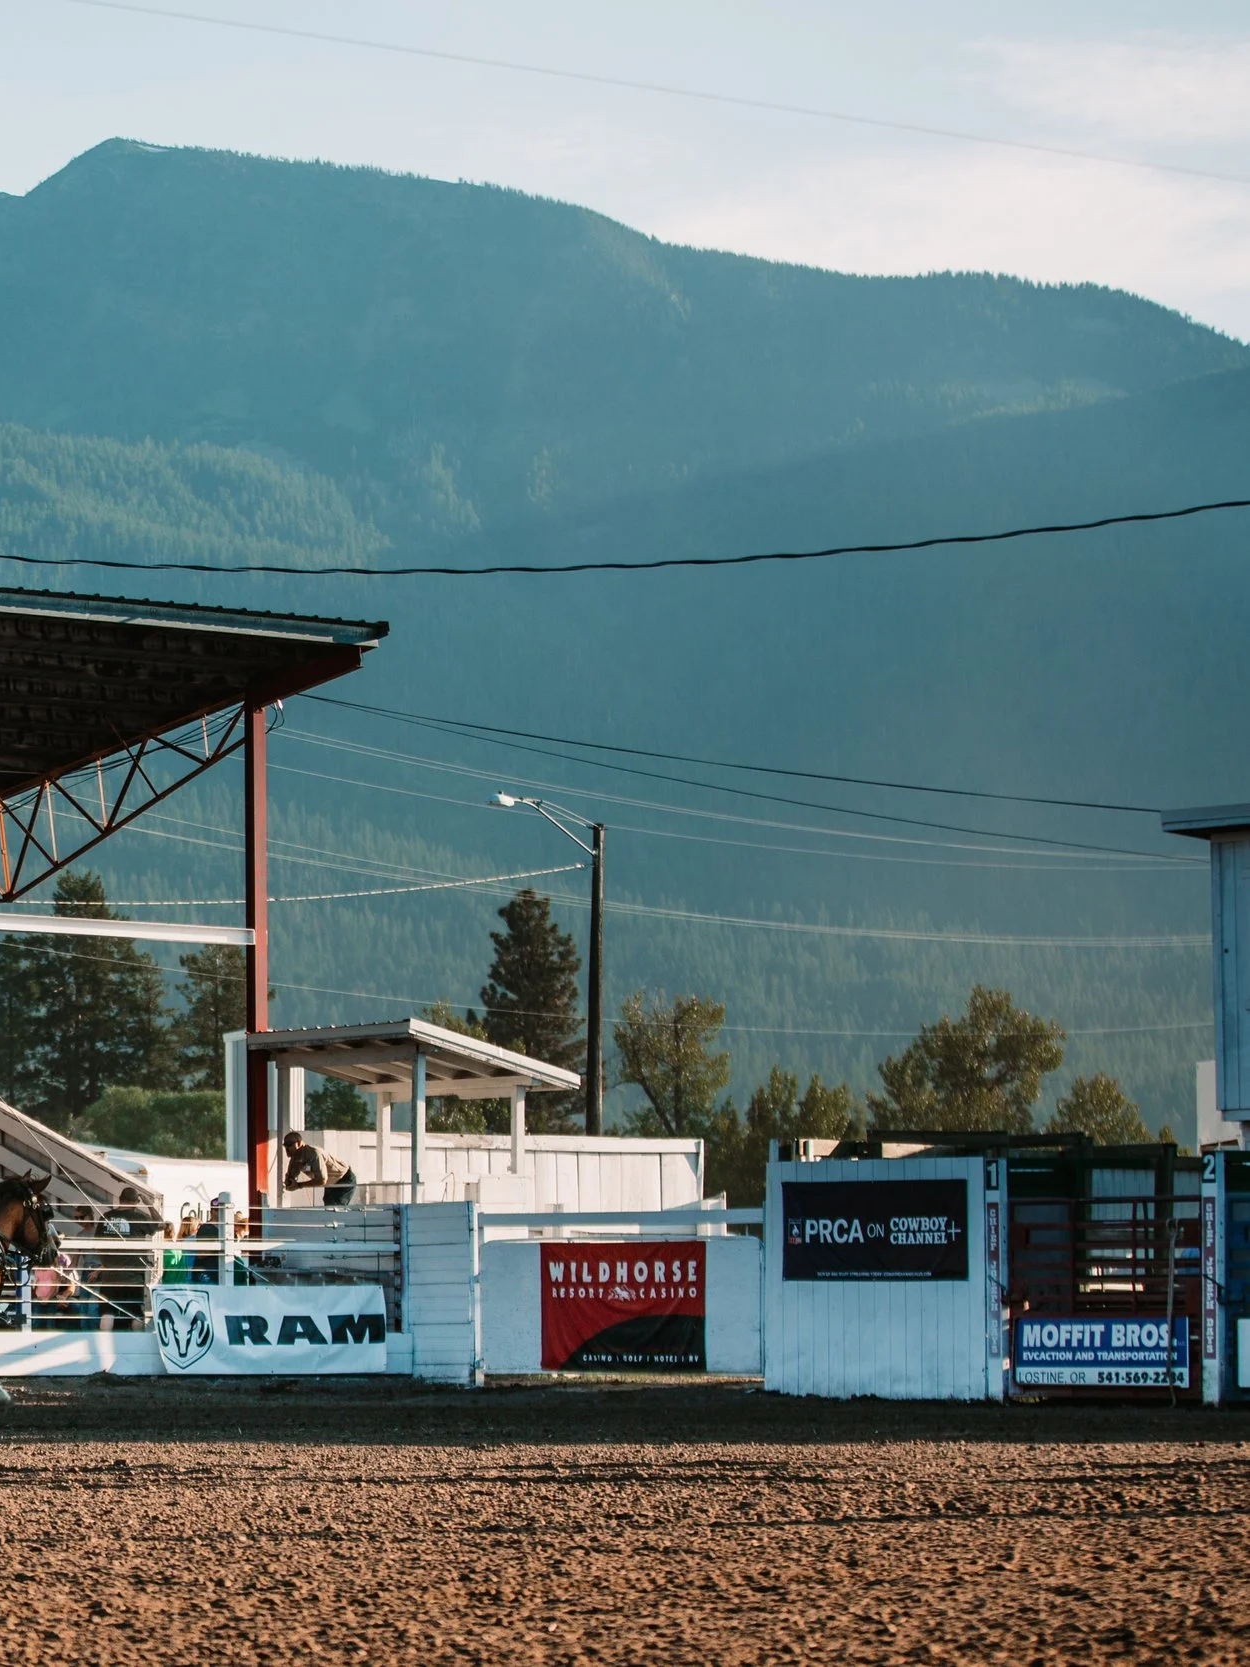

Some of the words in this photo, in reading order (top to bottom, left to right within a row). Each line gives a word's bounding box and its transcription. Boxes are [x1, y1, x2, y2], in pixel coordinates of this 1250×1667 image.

[987, 1162, 997, 1187] 1
[1203, 1154, 1215, 1179] 2
[805, 1218, 865, 1244] PRCA
[866, 1223, 885, 1238] ON
[889, 1216, 948, 1231] COWBOY
[989, 1208, 998, 1251] CHIEF
[1206, 1203, 1214, 1248] CHIEF
[889, 1231, 948, 1245] CHANNEL
[548, 1260, 698, 1283] WILDHORSE
[552, 1287, 605, 1299] RESORT
[639, 1287, 698, 1299] CASINO
[224, 1313, 386, 1346] RAM
[1023, 1323, 1105, 1347] MOFFIT
[1111, 1323, 1178, 1347] BROS.
[1206, 1318, 1215, 1353] DAYS
[582, 1354, 612, 1362] CASINO
[623, 1354, 643, 1362] GOLF
[654, 1355, 678, 1363] HOTEL
[689, 1355, 699, 1363] RV
[1022, 1351, 1073, 1361] EVCACTION
[1075, 1351, 1095, 1361] AND
[1018, 1371, 1067, 1385] LOSTINE,
[1069, 1371, 1086, 1383] OR
